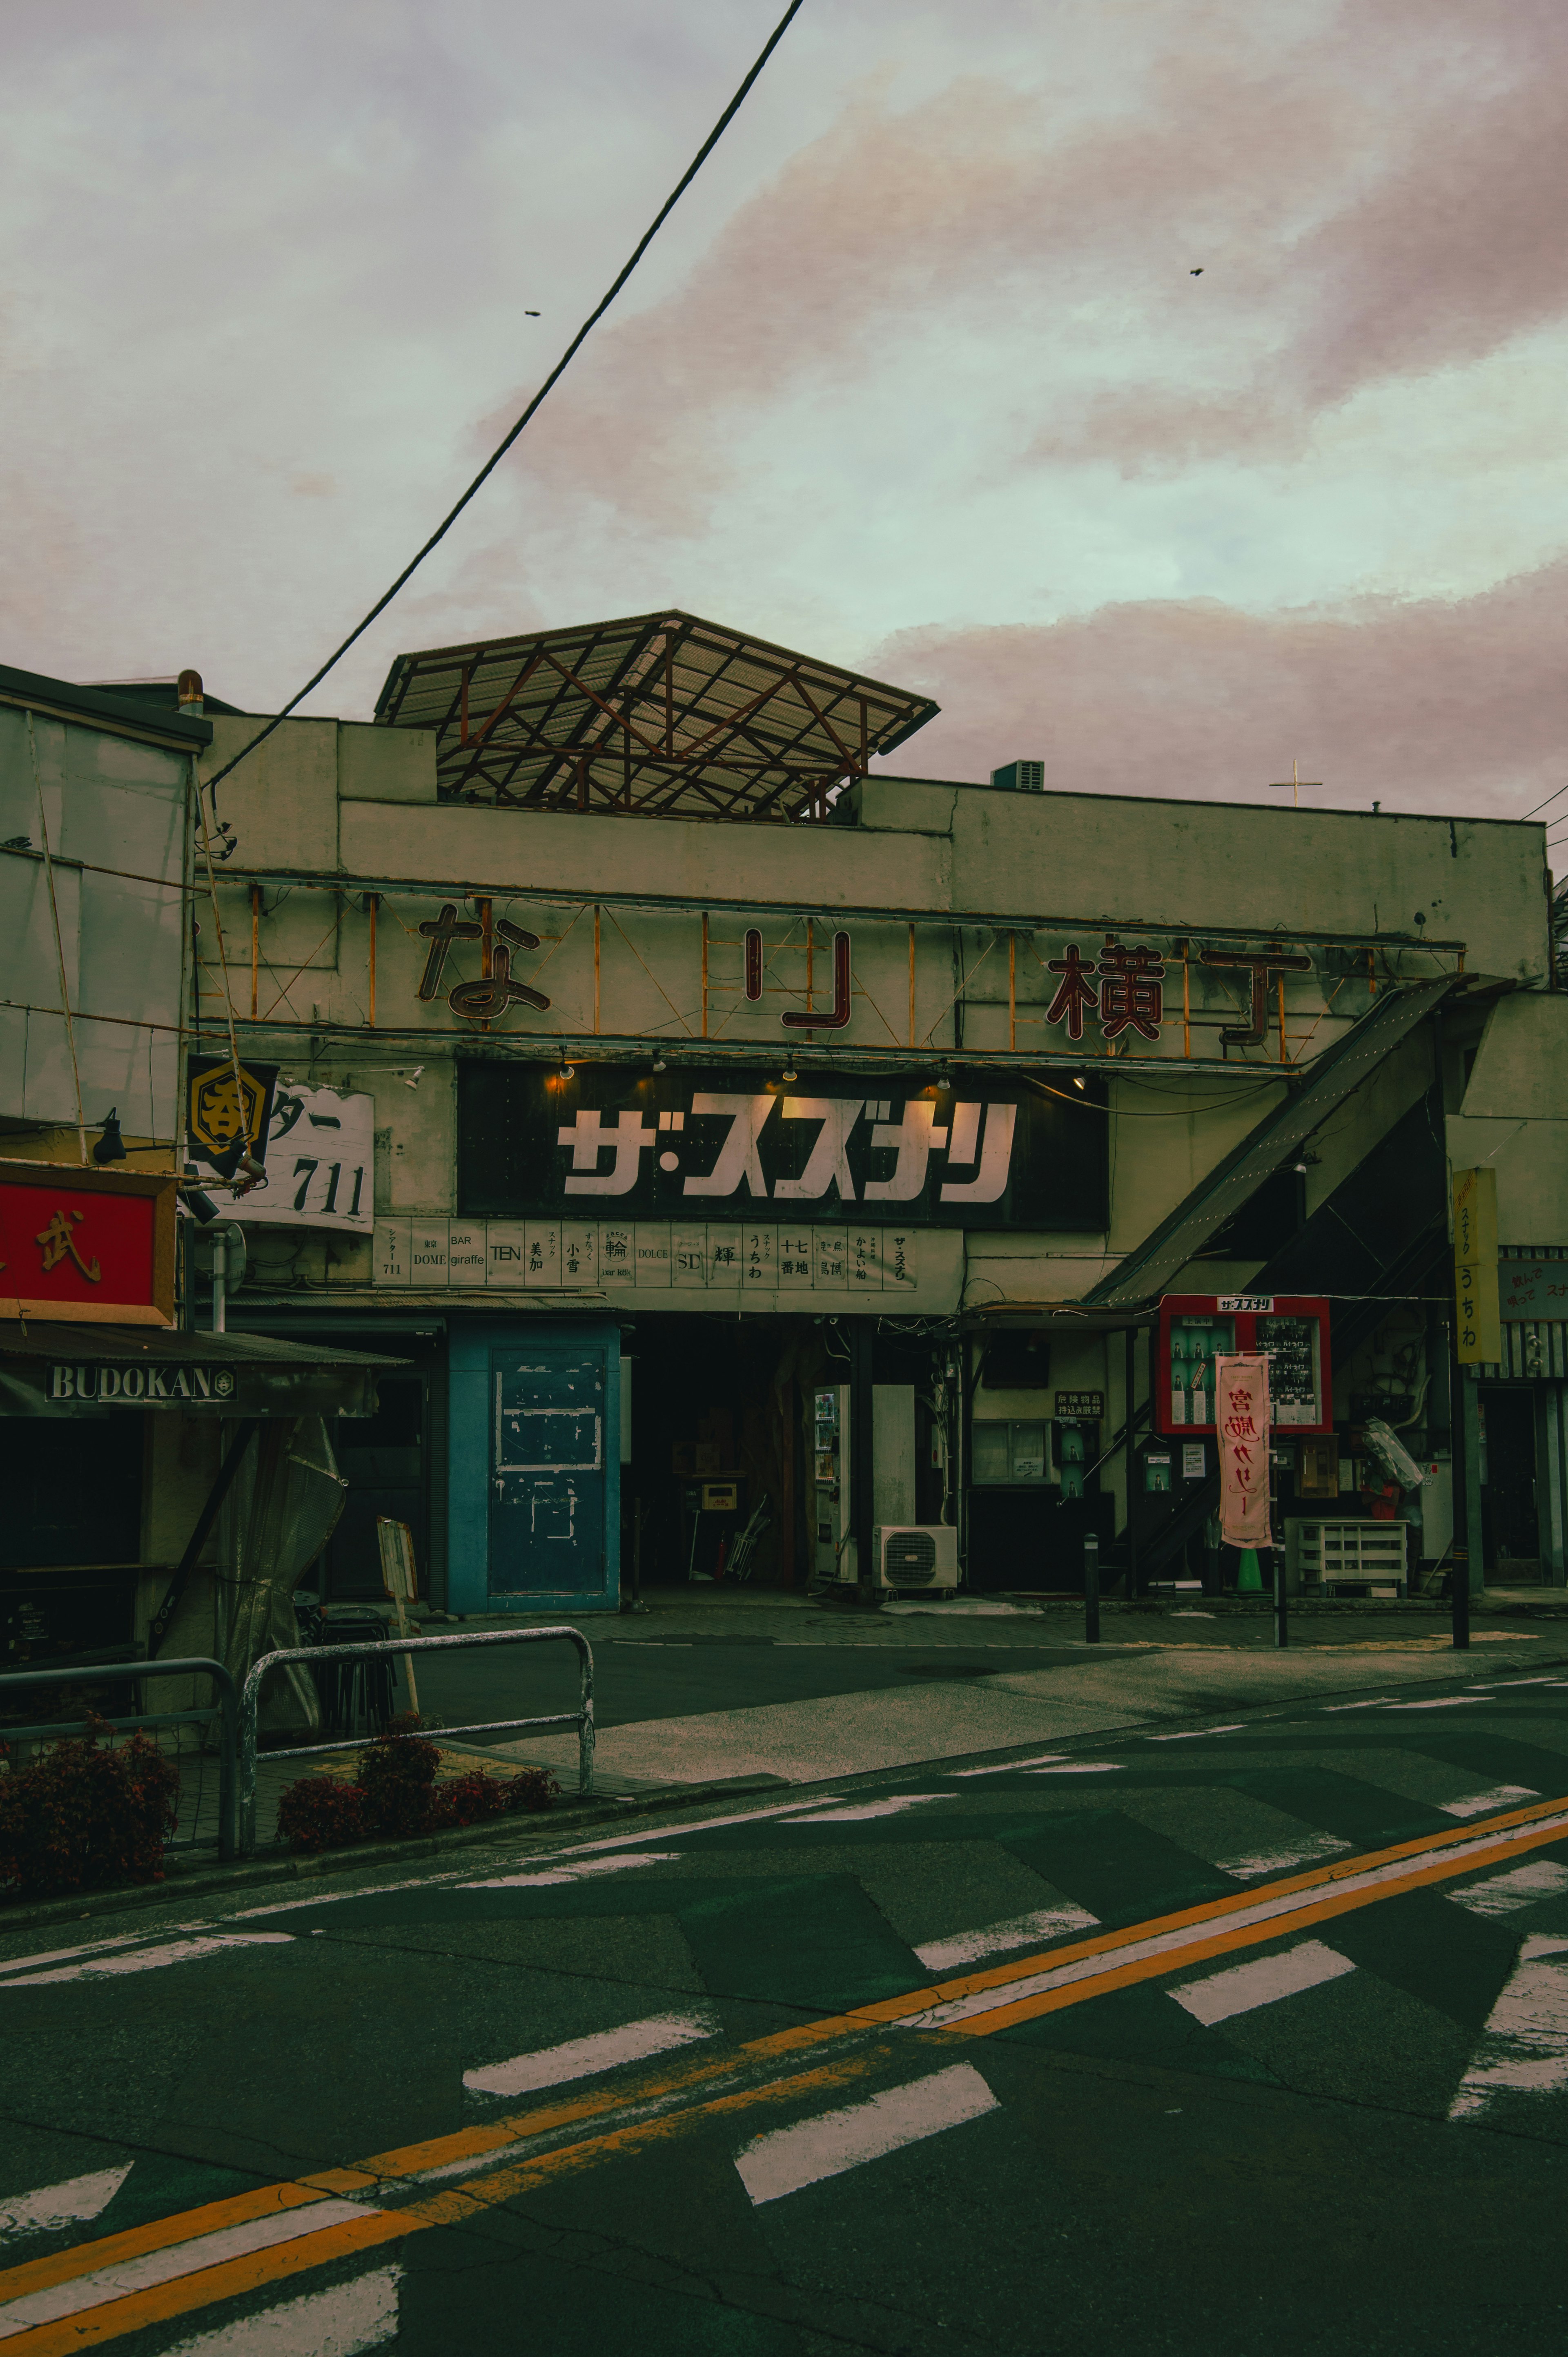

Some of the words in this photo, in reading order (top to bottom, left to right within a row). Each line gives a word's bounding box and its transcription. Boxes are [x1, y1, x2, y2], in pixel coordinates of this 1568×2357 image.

[557, 1093, 1017, 1204] ザ・スズナリ
[293, 1159, 364, 1216] 711
[1461, 1208, 1470, 1255] スナック
[424, 1240, 437, 1248] 東京
[606, 1240, 627, 1258] 輪
[781, 1240, 808, 1253] 十七
[414, 1255, 446, 1264] DOME
[451, 1254, 484, 1266] giraffe
[490, 1246, 521, 1260] TEN
[529, 1242, 543, 1271] 美加
[567, 1244, 580, 1273] 小雪
[639, 1249, 668, 1258] DOLCE
[749, 1235, 762, 1278] うちわ
[855, 1237, 867, 1280] かよい船
[894, 1238, 906, 1280] ザ・スズナリ
[383, 1264, 401, 1274] 711
[781, 1261, 808, 1274] 番地
[1221, 1299, 1270, 1310] ザ・スズナリ
[1461, 1268, 1476, 1347] うちわ
[51, 1366, 212, 1398] BUDOKAN
[1058, 1394, 1100, 1404] 危険物品
[1058, 1405, 1101, 1415] 持込み厳禁
